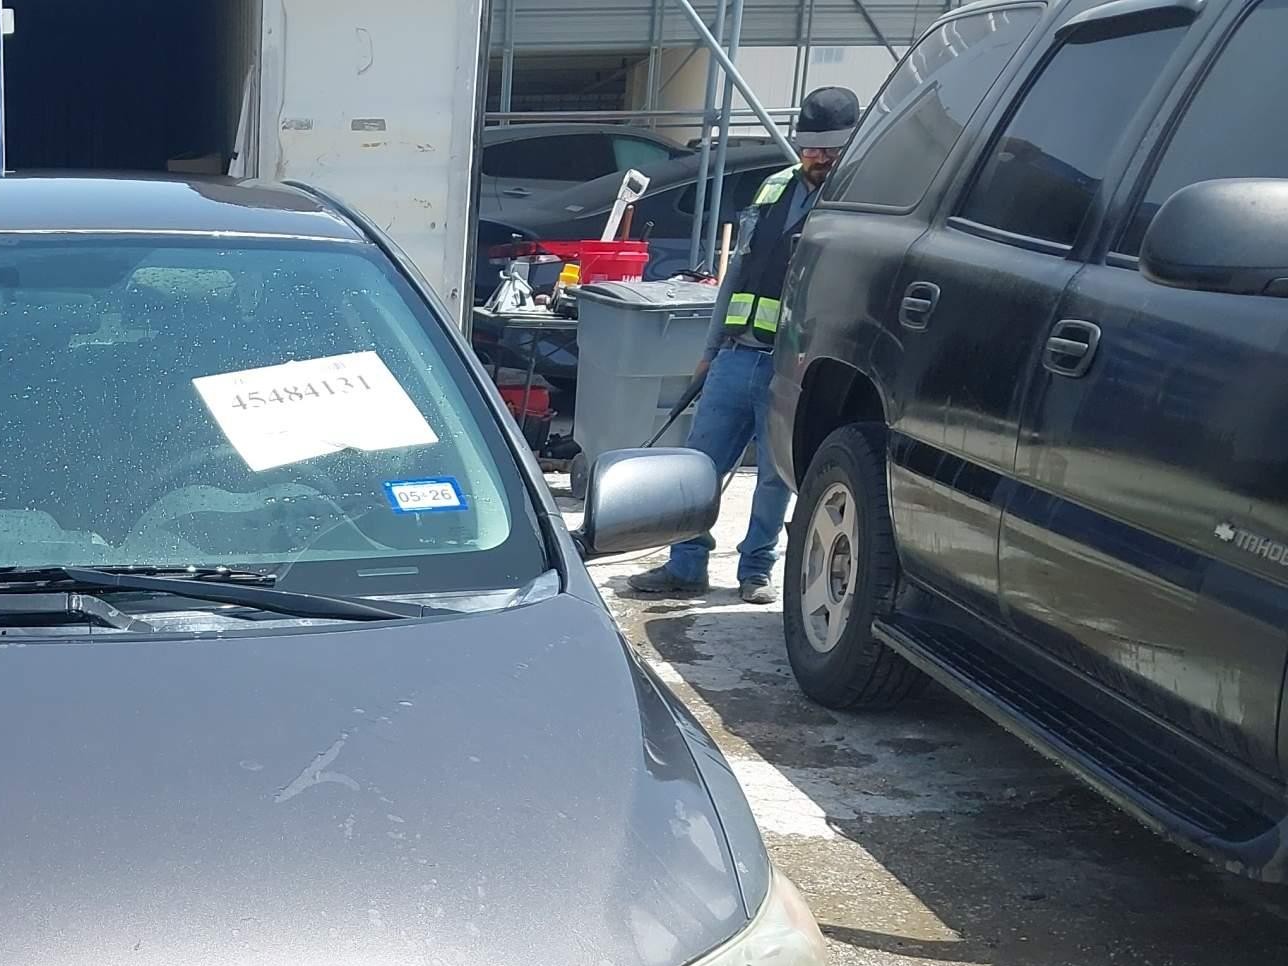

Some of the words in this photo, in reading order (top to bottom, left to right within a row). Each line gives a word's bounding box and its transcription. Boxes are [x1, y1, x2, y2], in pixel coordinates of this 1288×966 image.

[232, 375, 372, 410] 45484131
[398, 491, 421, 503] 05
[429, 489, 452, 501] 26
